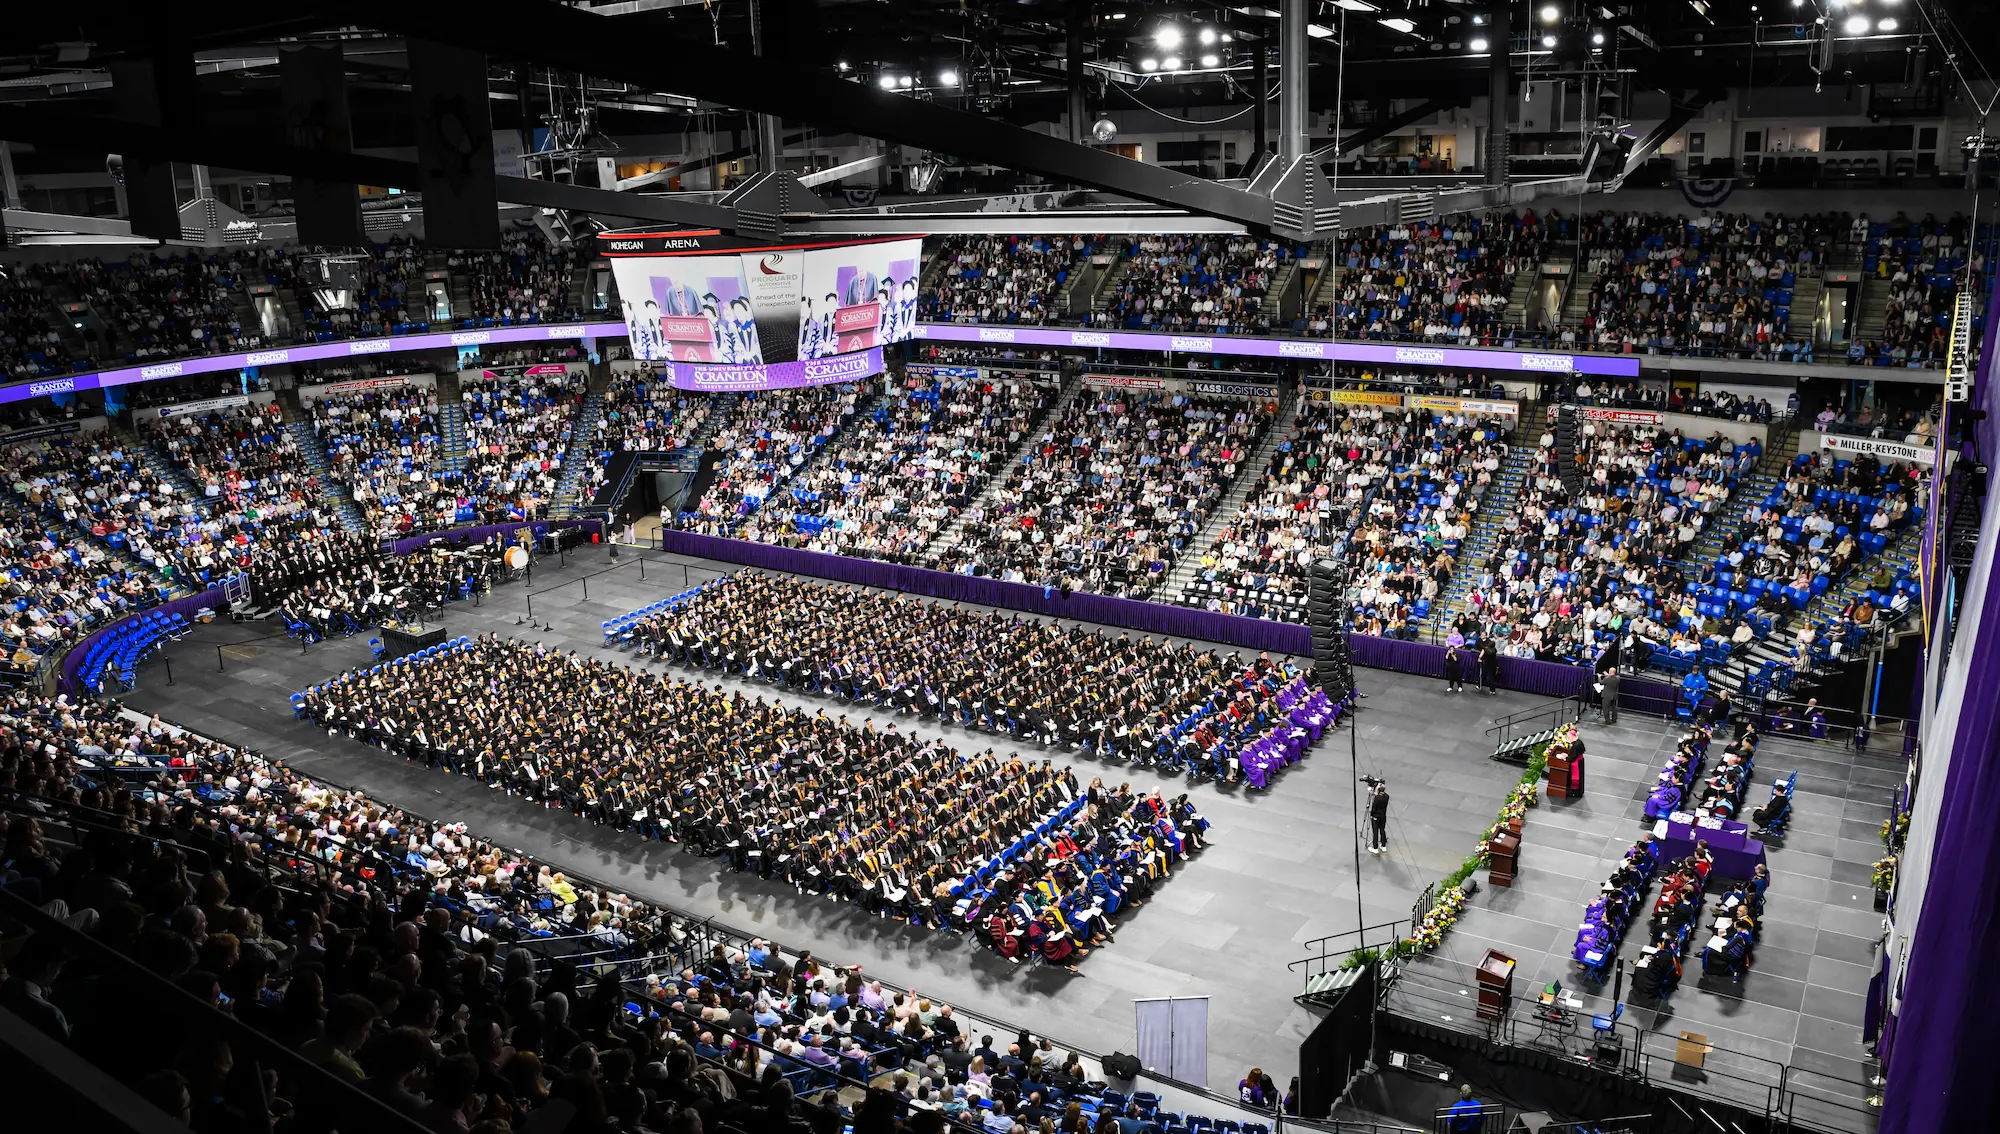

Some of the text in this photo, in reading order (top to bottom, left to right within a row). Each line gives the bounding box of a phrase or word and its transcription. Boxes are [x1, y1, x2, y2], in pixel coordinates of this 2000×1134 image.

[610, 239, 700, 250] MOHEGAN ARENA
[751, 274, 798, 283] PROGUARD
[757, 300, 796, 308] Unexpected
[668, 324, 704, 334] SCRANTON
[1279, 344, 1324, 355] SCRANTON
[823, 355, 860, 363] UNIVERSITY
[1396, 350, 1444, 361] SCRANTON
[804, 357, 869, 379] SCRANTON
[1522, 357, 1574, 368] SCRANTON
[694, 370, 768, 384] SCRANTON
[30, 381, 74, 395] SCRANTON
[1196, 383, 1269, 396] KASS LOGISTICS
[1366, 394, 1399, 402] DENTAL
[1840, 439, 1917, 458] MILLER-KEYSTONE
